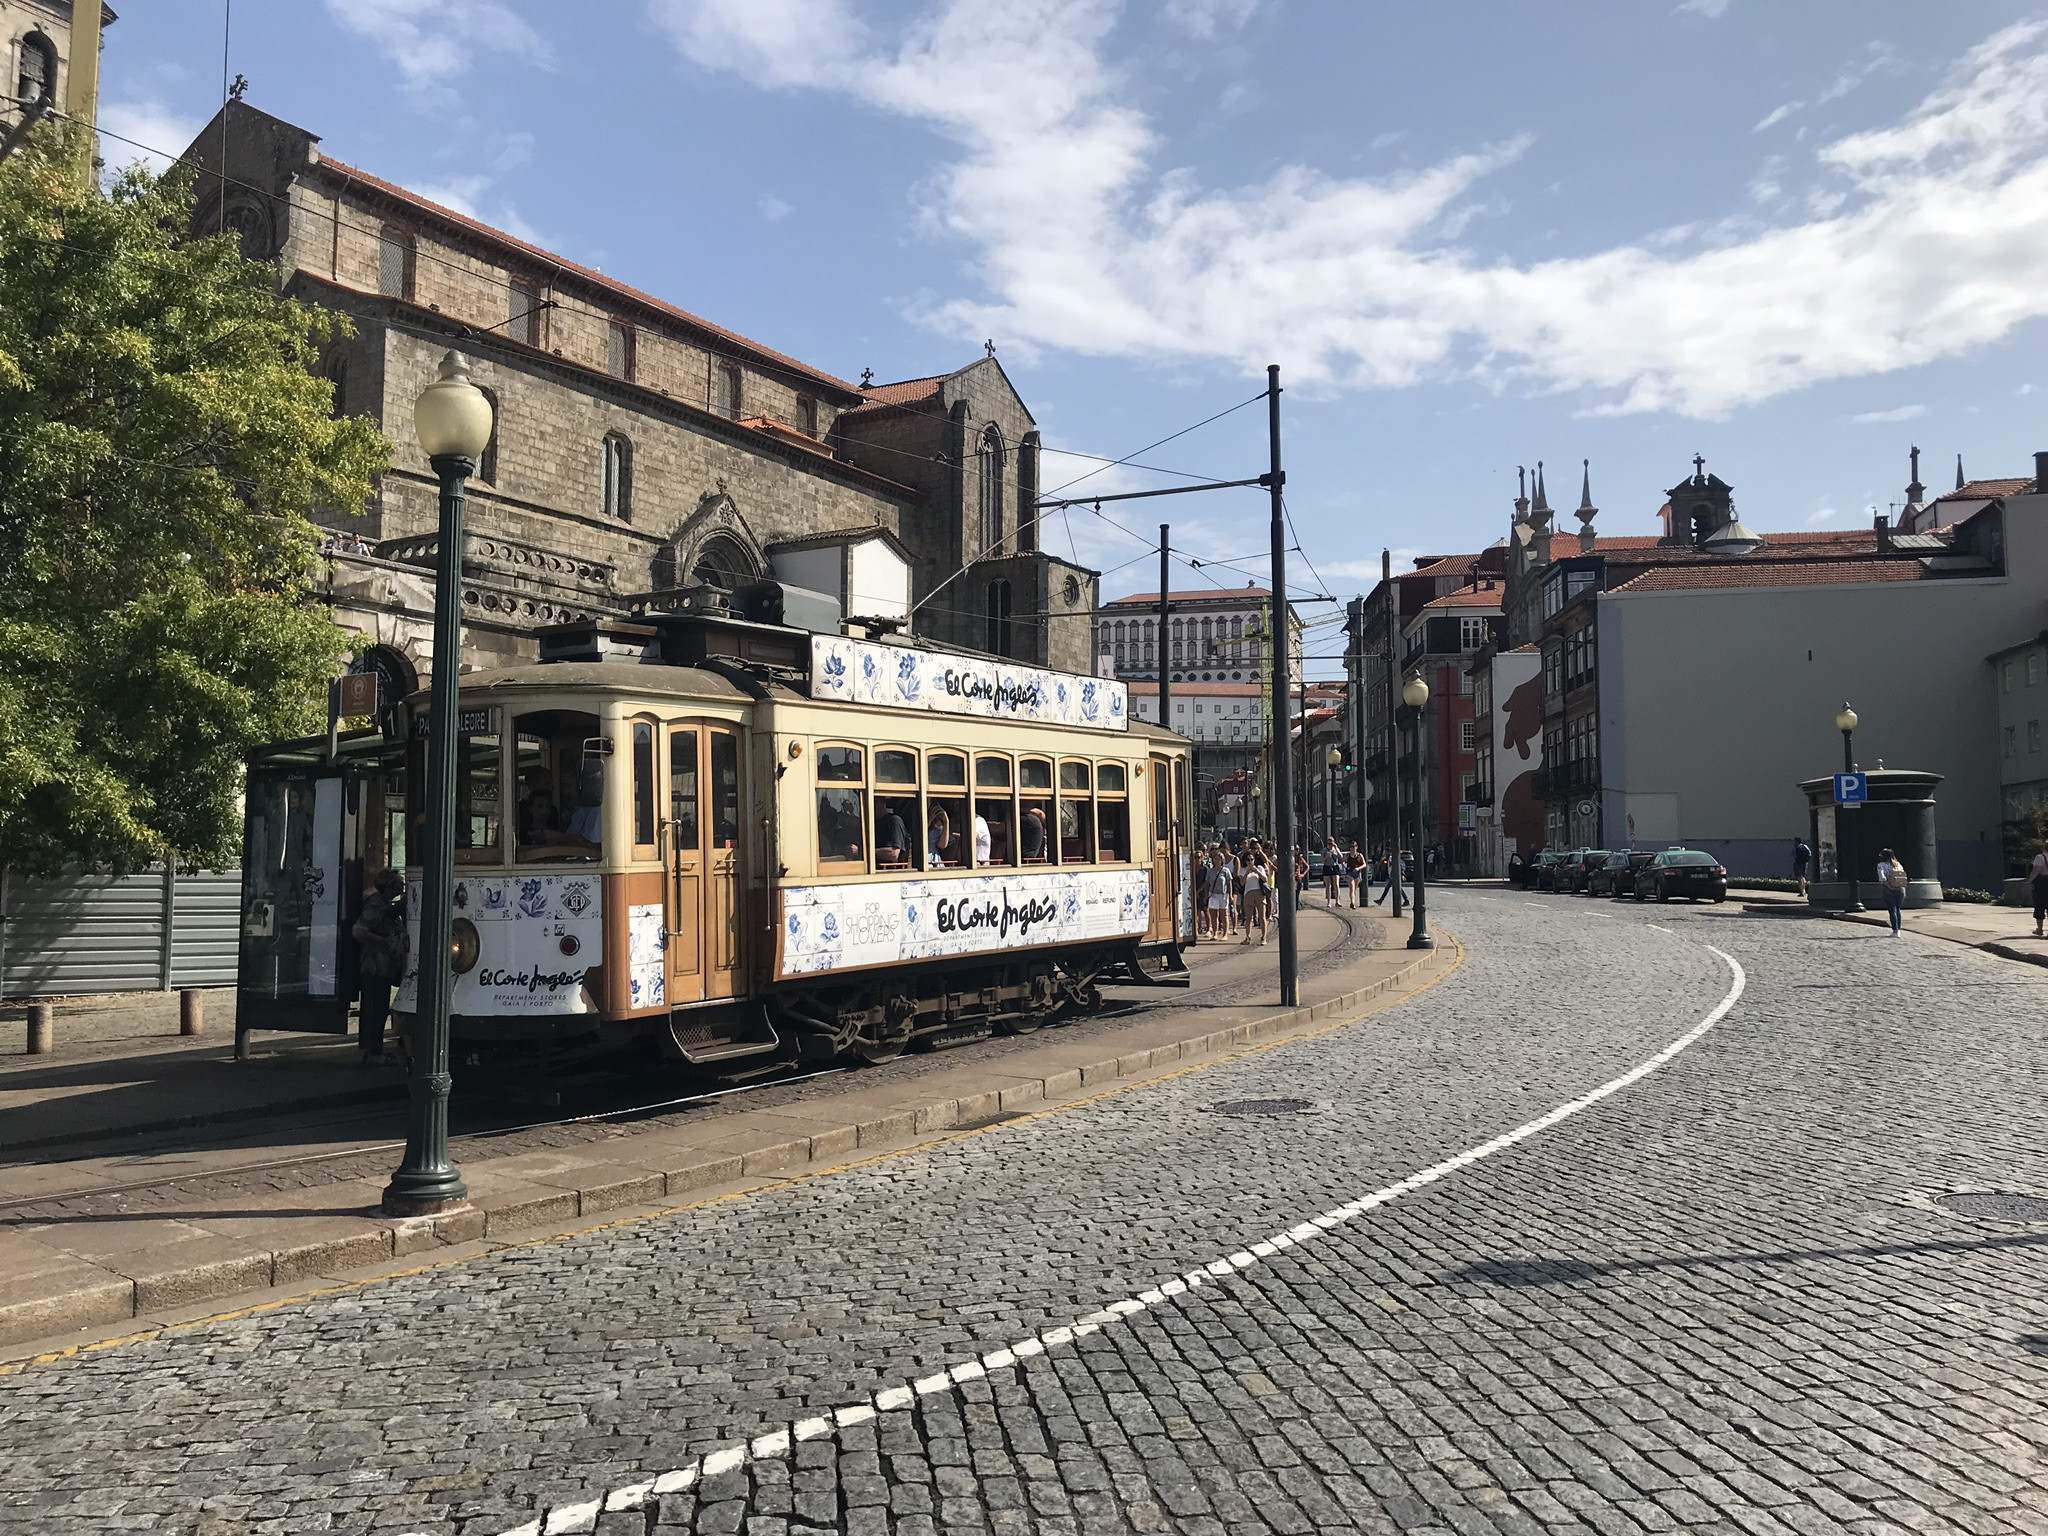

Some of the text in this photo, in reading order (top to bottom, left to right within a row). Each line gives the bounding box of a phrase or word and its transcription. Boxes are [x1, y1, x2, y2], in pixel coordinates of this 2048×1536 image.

[945, 669, 1037, 712] El Corte Inglés
[387, 709, 396, 736] 1
[1840, 775, 1859, 799] P
[865, 902, 880, 914] FOR
[937, 898, 955, 933] El
[957, 898, 998, 931] Corte
[1000, 886, 1056, 939] Inglés
[845, 913, 900, 935] SHOPPING
[852, 924, 895, 946] LOVERS
[479, 968, 492, 986] El
[494, 969, 528, 986] Corte
